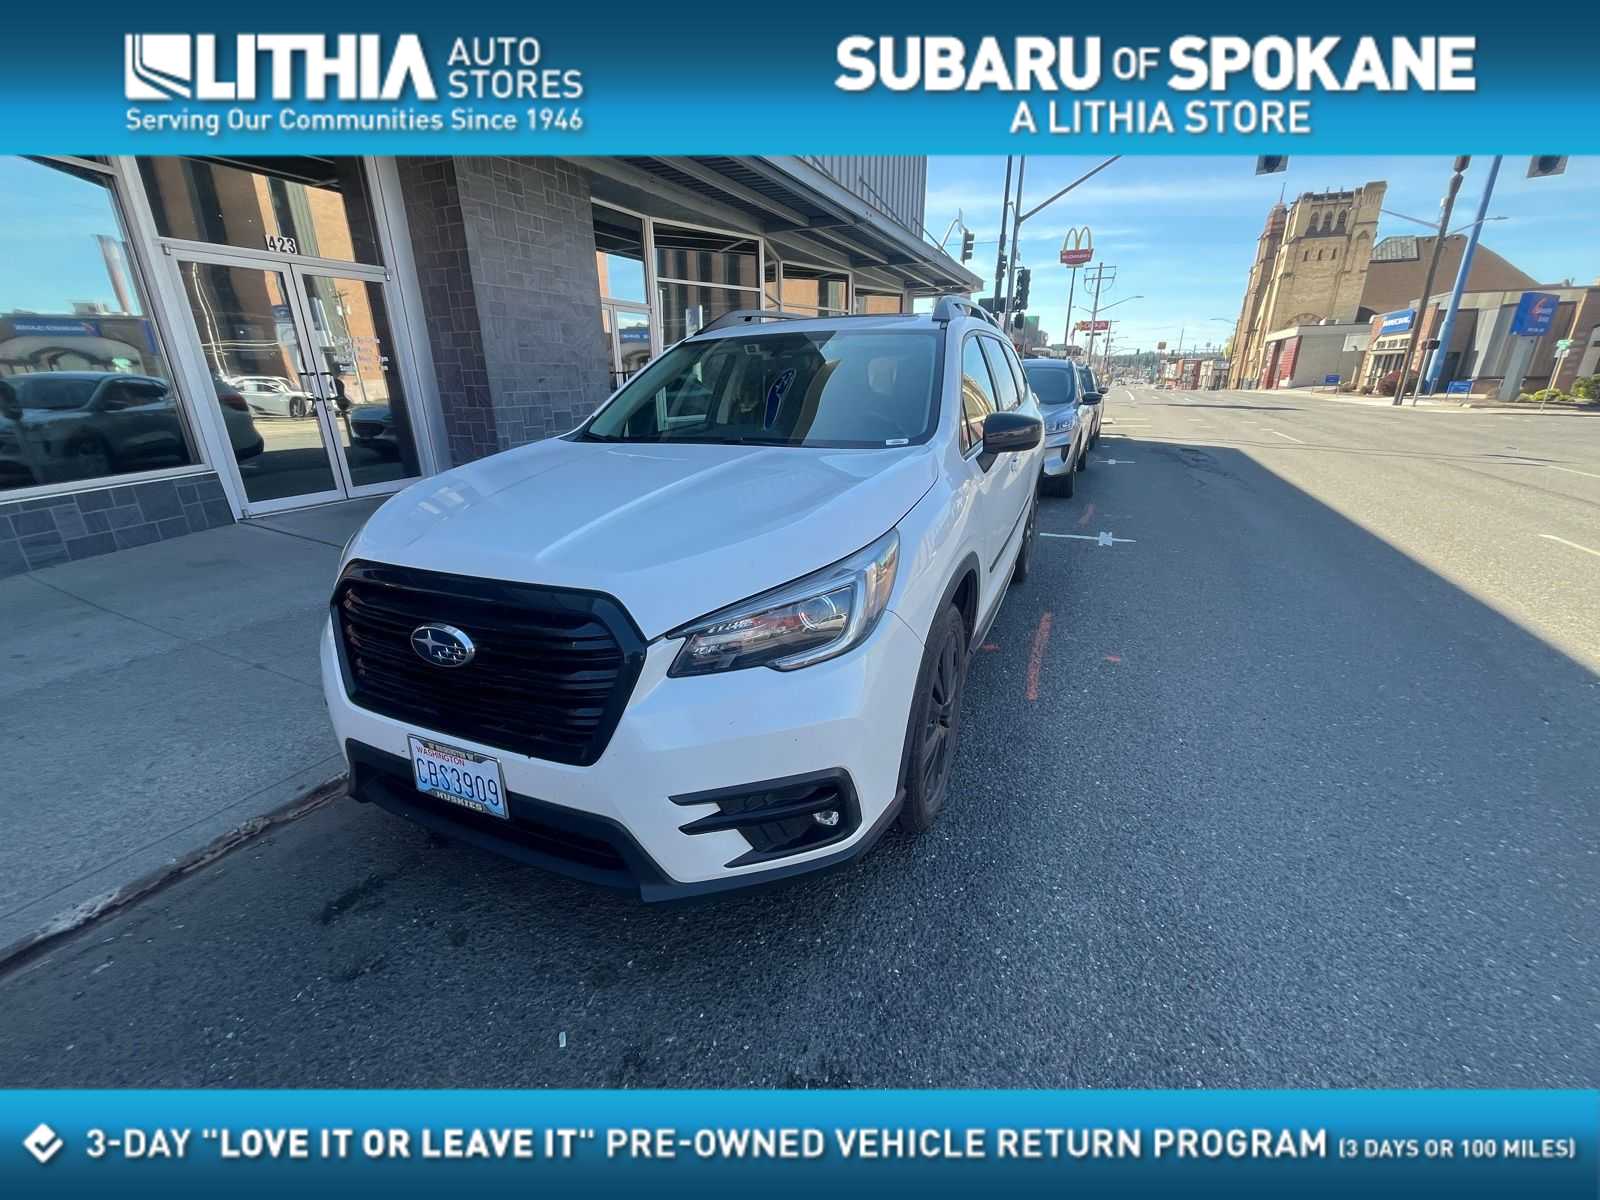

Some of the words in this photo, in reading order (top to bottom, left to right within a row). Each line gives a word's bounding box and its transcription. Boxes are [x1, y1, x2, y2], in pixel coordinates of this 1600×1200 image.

[269, 235, 296, 254] 423
[416, 745, 465, 767] WASHINGTON
[416, 757, 500, 807] CBS3909
